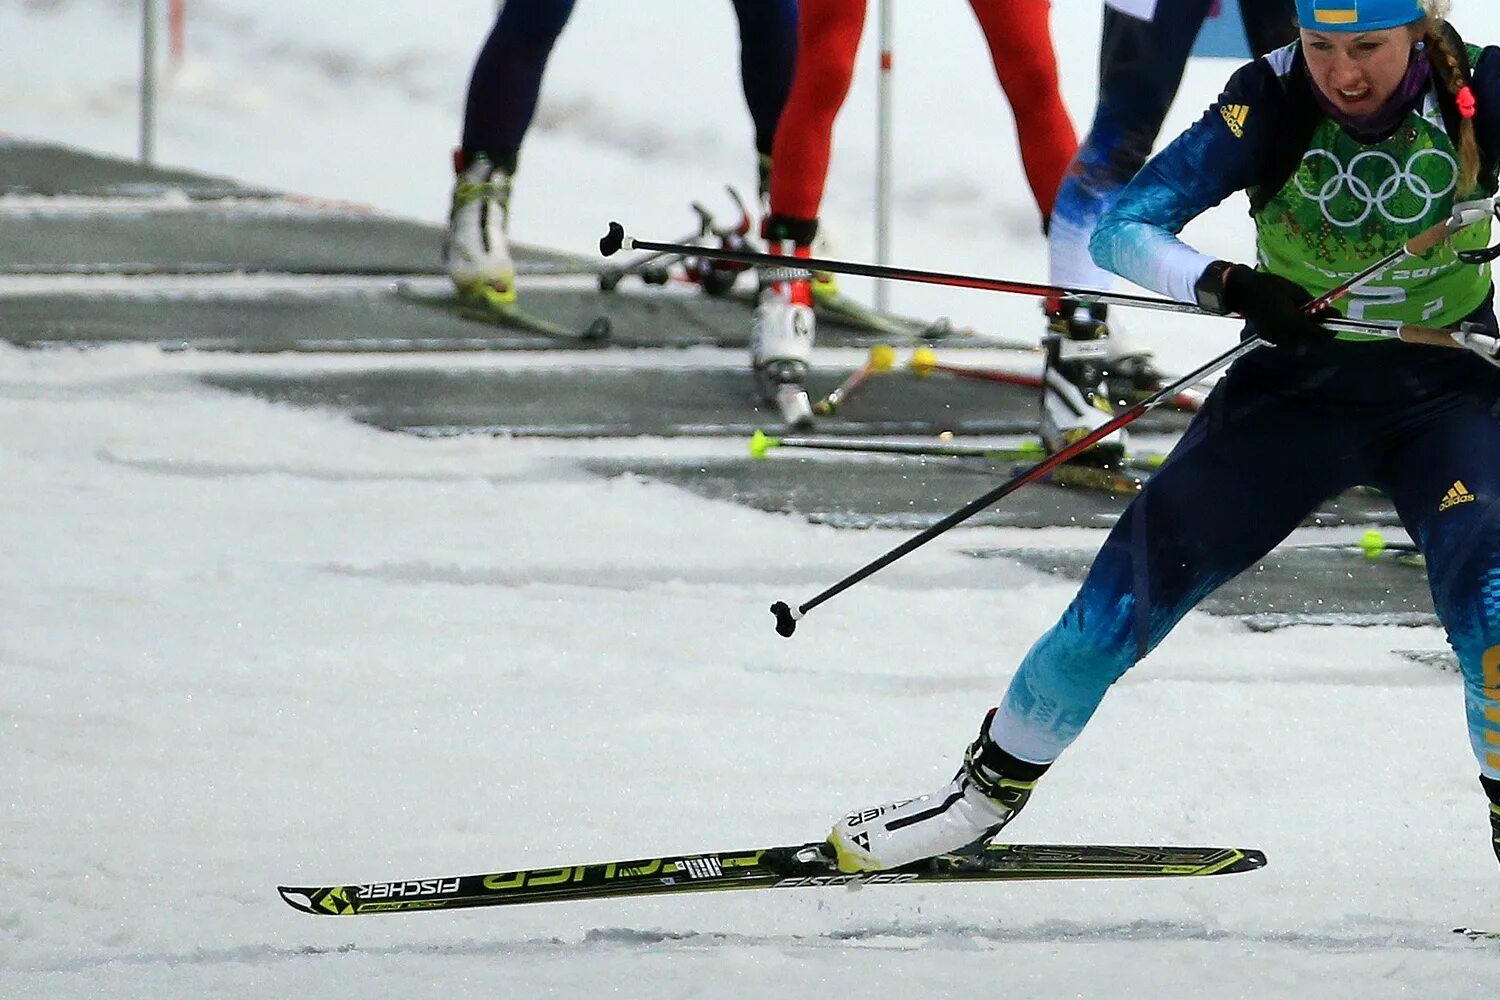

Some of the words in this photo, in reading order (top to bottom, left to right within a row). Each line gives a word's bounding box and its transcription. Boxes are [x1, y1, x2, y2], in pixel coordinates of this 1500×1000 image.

[1220, 105, 1244, 138] adidas
[1438, 493, 1475, 512] adidas
[357, 877, 461, 899] FISCHER
